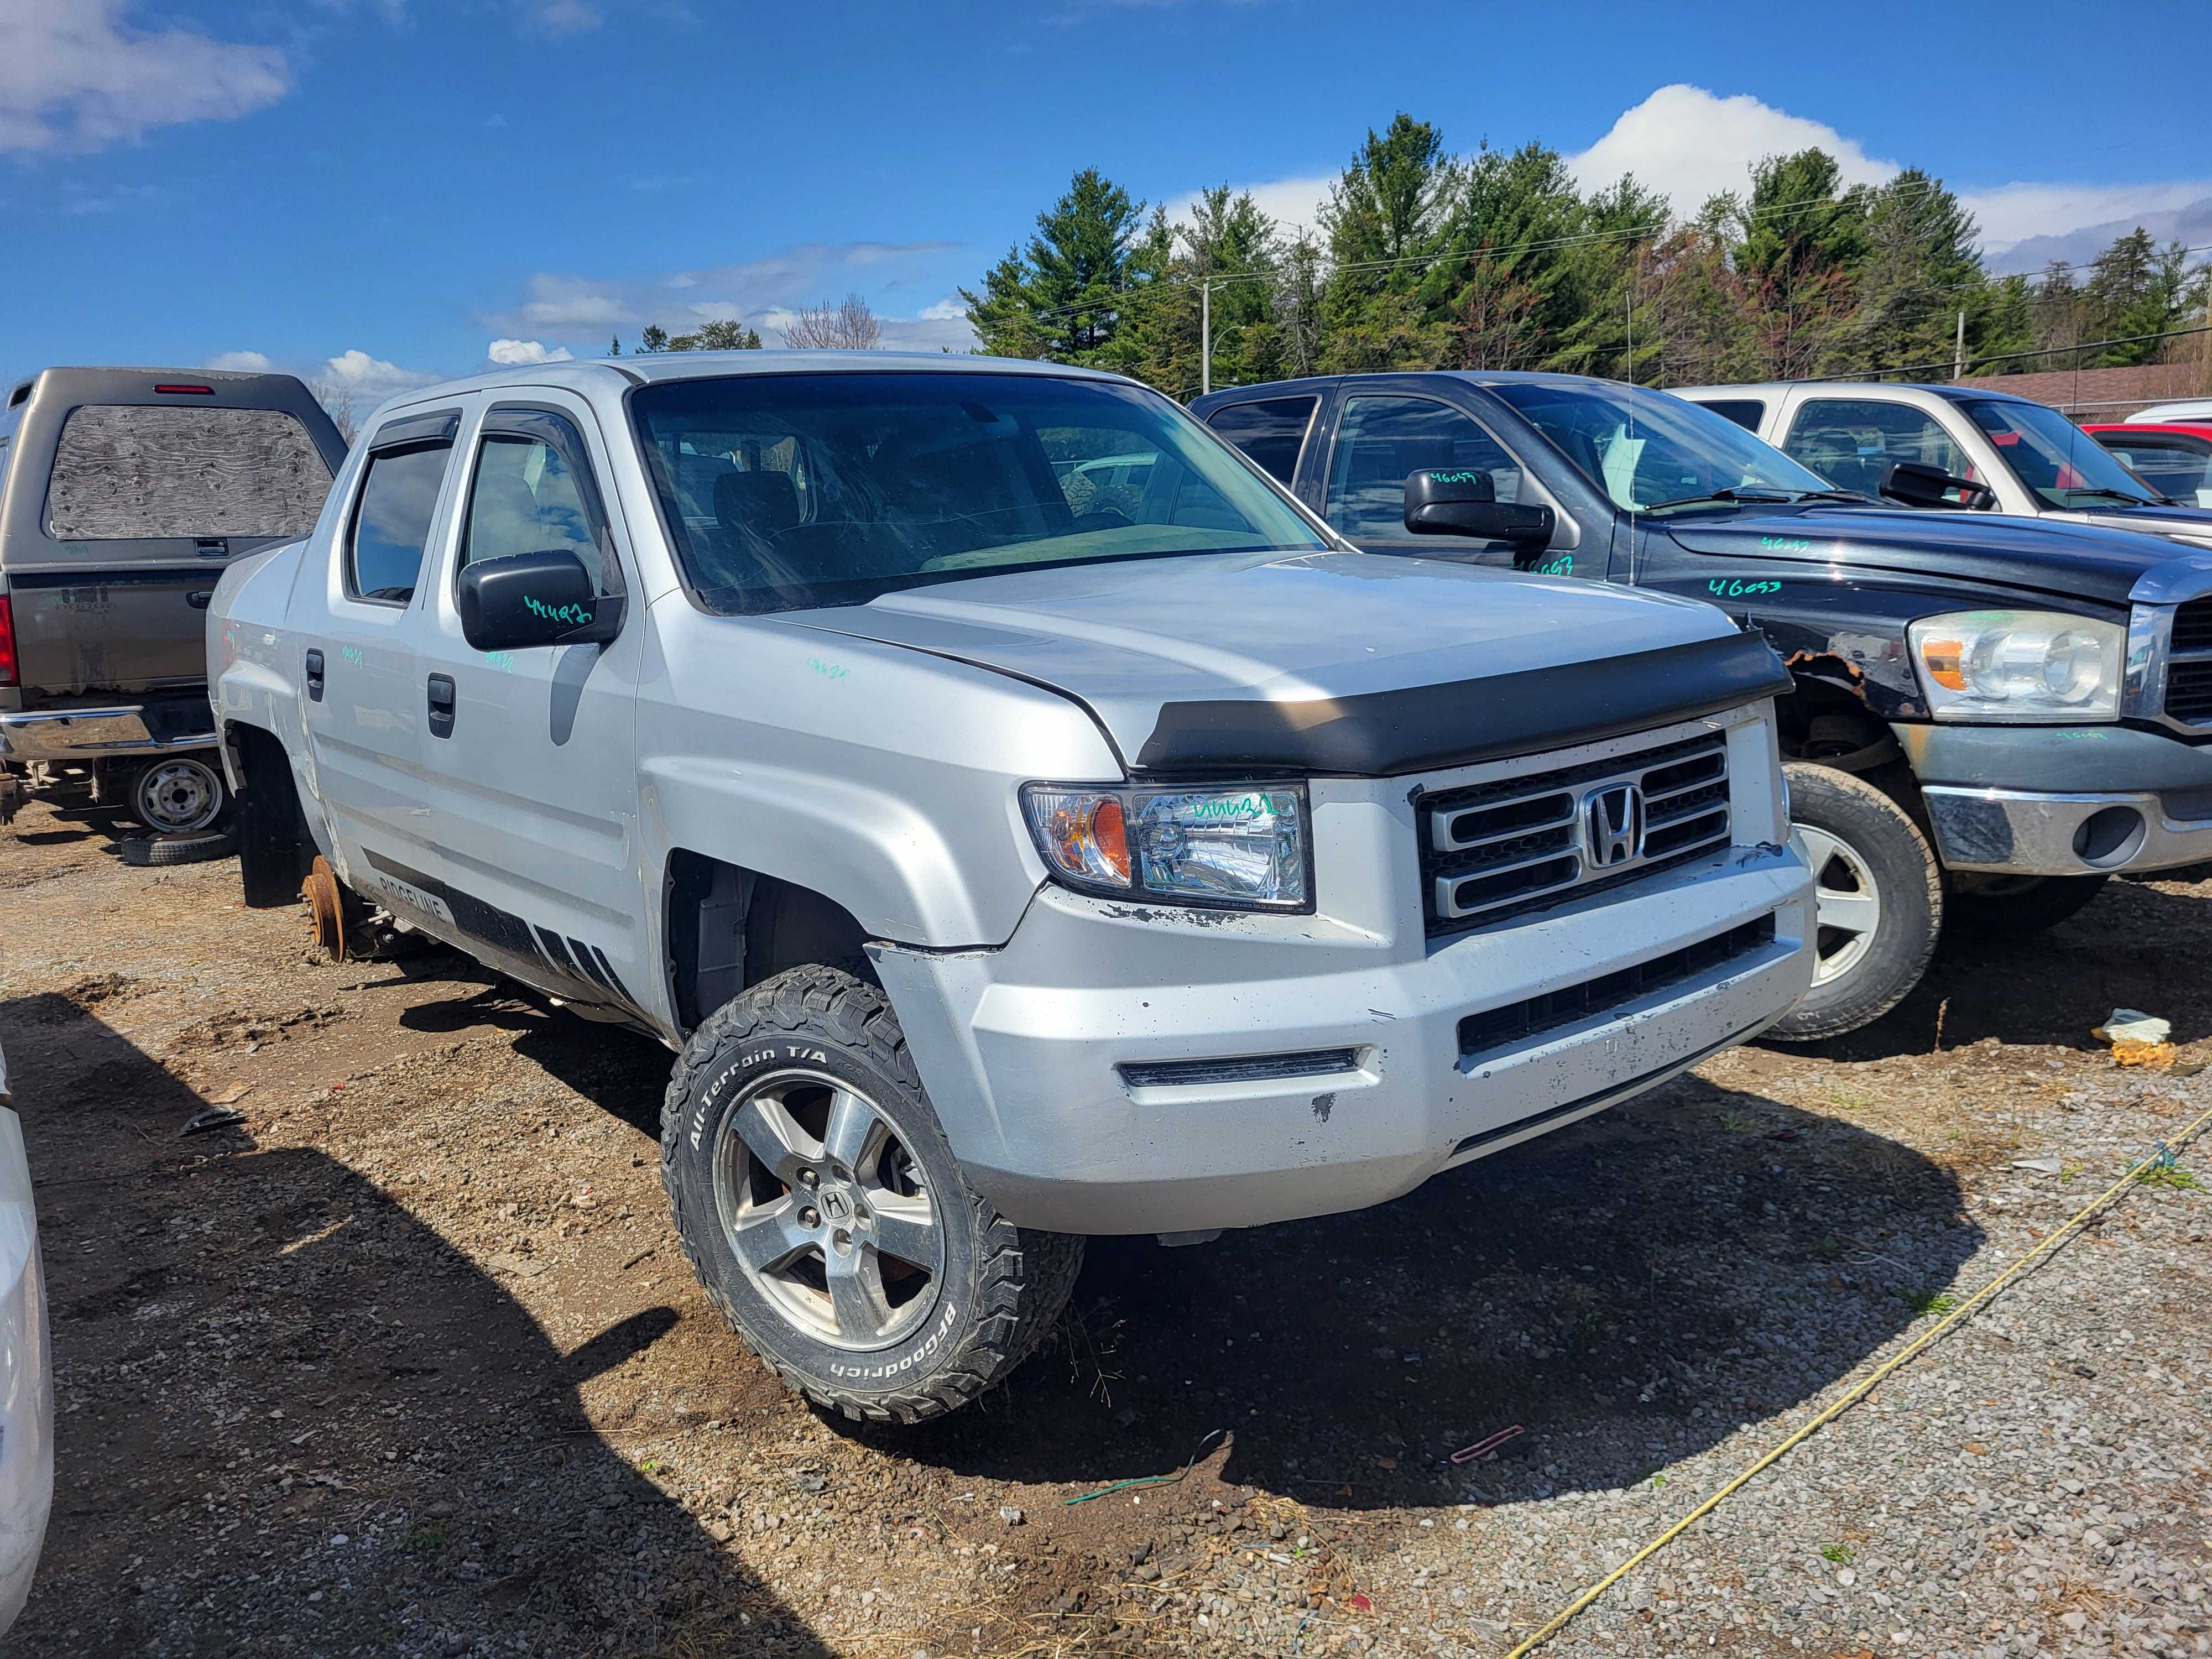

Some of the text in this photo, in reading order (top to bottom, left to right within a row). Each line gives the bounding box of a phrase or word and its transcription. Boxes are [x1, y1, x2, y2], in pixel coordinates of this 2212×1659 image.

[379, 877, 447, 924] RIDGELINE
[691, 1049, 776, 1152] All-Terrain
[786, 1046, 827, 1064] T/A
[830, 1301, 957, 1381] BFGoodrich
